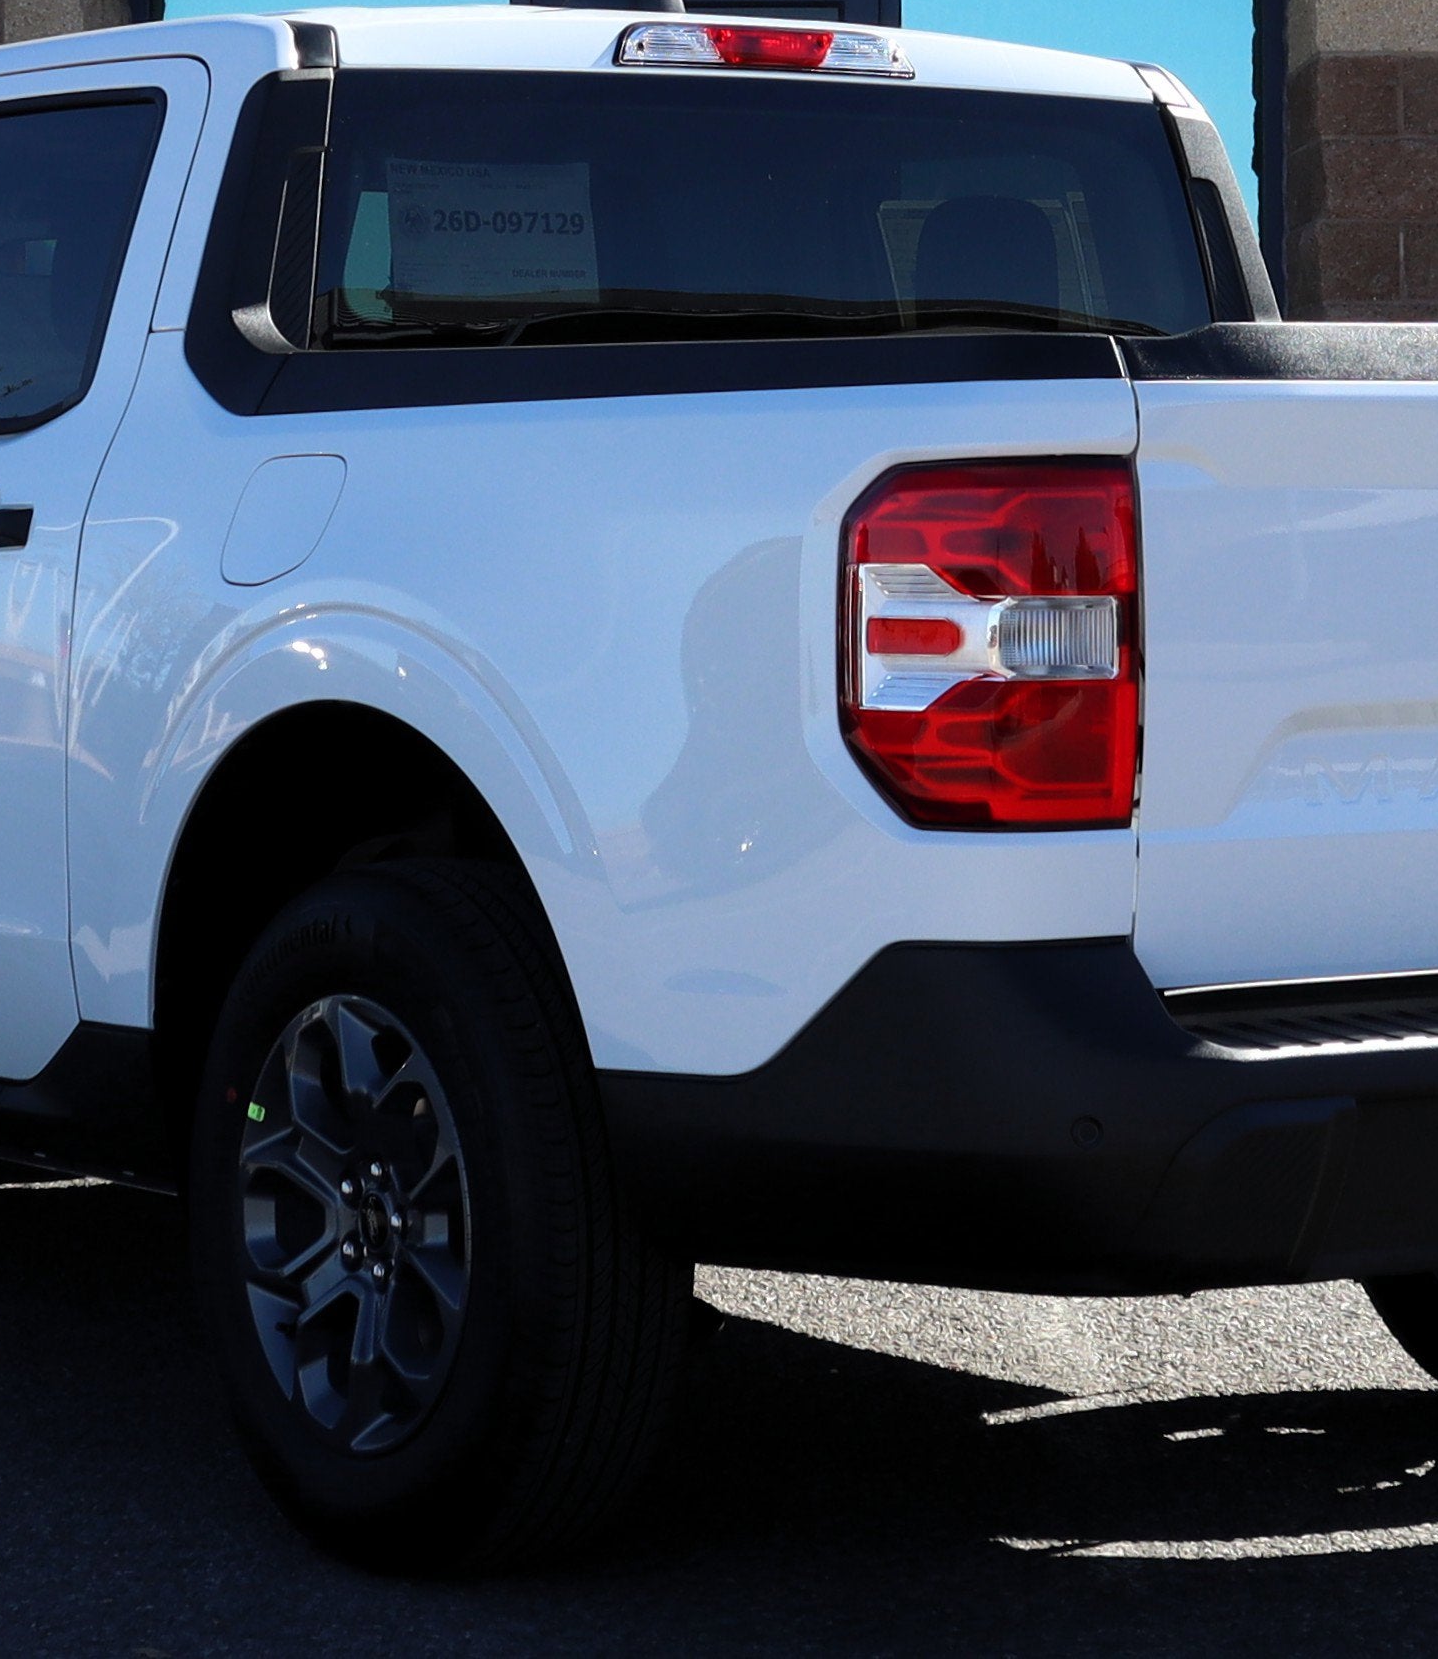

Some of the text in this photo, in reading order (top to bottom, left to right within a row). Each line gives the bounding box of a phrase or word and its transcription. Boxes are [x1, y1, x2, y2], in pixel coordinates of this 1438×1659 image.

[420, 164, 464, 177] MEXICO
[467, 167, 491, 178] USA
[433, 209, 584, 235] 26D-097129
